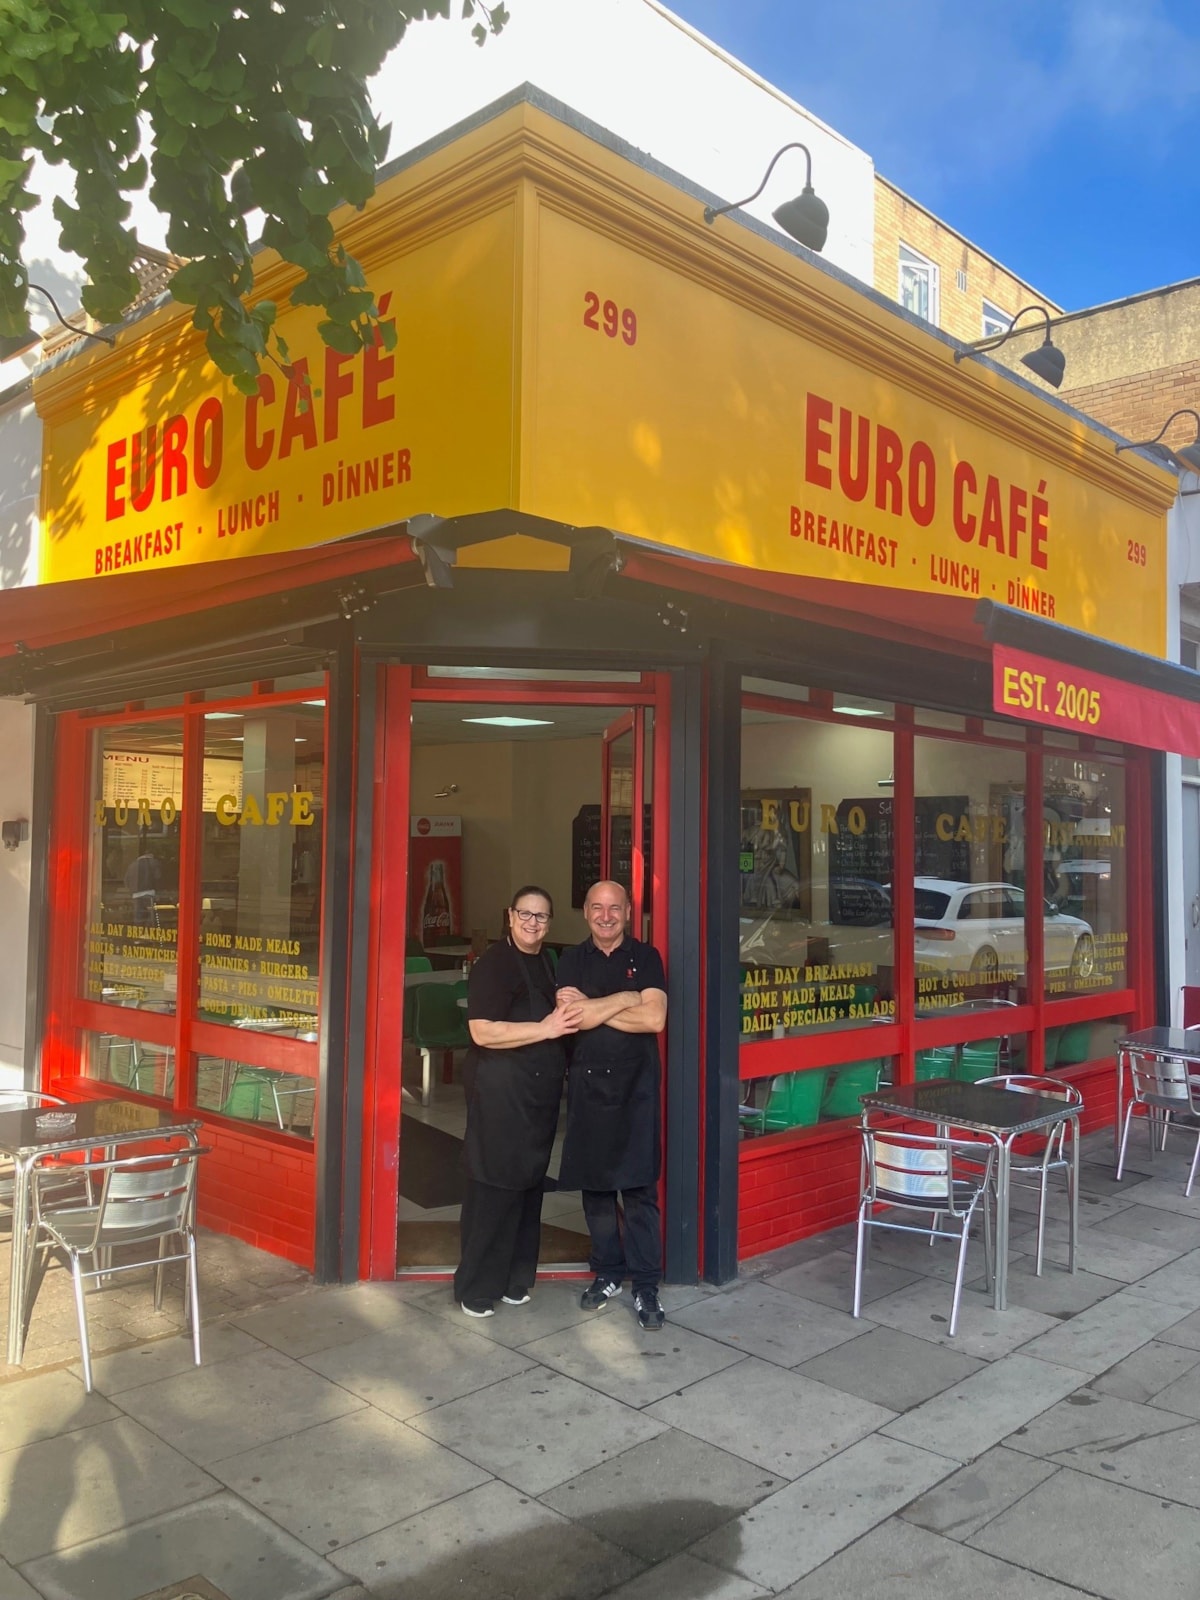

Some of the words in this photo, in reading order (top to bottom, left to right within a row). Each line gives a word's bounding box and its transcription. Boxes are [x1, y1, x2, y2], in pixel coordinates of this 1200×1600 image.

[584, 291, 637, 346] 299
[106, 396, 223, 522] EURO
[244, 290, 396, 471] CAFÉ
[805, 392, 936, 527] EURO
[953, 460, 1049, 570] CAFÉ
[95, 522, 184, 575] BREAKFAST
[217, 490, 280, 538] LUNCH
[790, 505, 898, 568] BREAKFAST
[931, 553, 980, 594] LUNCH
[1127, 539, 1147, 567] 299
[1004, 667, 1050, 712] EST.
[1055, 681, 1101, 724] 2005
[103, 755, 150, 763] MENU
[95, 797, 177, 826] EURO
[215, 791, 315, 826] CAFE
[760, 798, 867, 836] EURO
[935, 812, 1008, 844] CAFE
[90, 922, 105, 936] ALL
[107, 923, 124, 937] DAY
[127, 925, 178, 942] BREAKFAST
[205, 932, 232, 948] HOME
[235, 935, 263, 951] MADE
[267, 938, 300, 956] MEALS
[205, 954, 249, 973] PANINIES
[261, 961, 308, 980] BURGERS
[744, 970, 769, 988] ALL
[774, 967, 801, 984] DAY
[805, 961, 873, 982] BREAKFAST
[918, 976, 939, 992] HOT
[952, 971, 976, 988] COLD
[979, 967, 1018, 985] FILLINGS
[204, 976, 228, 993] PASTA
[238, 980, 257, 997] PIES
[743, 990, 778, 1010] HOME
[782, 987, 815, 1006] MADE
[820, 984, 856, 1002] MEALS
[204, 998, 228, 1014] COLD
[918, 991, 965, 1011] PANINIES
[743, 1012, 778, 1033] DAILY
[783, 1006, 837, 1028] SPECIALS
[849, 1000, 896, 1019] SALADS
